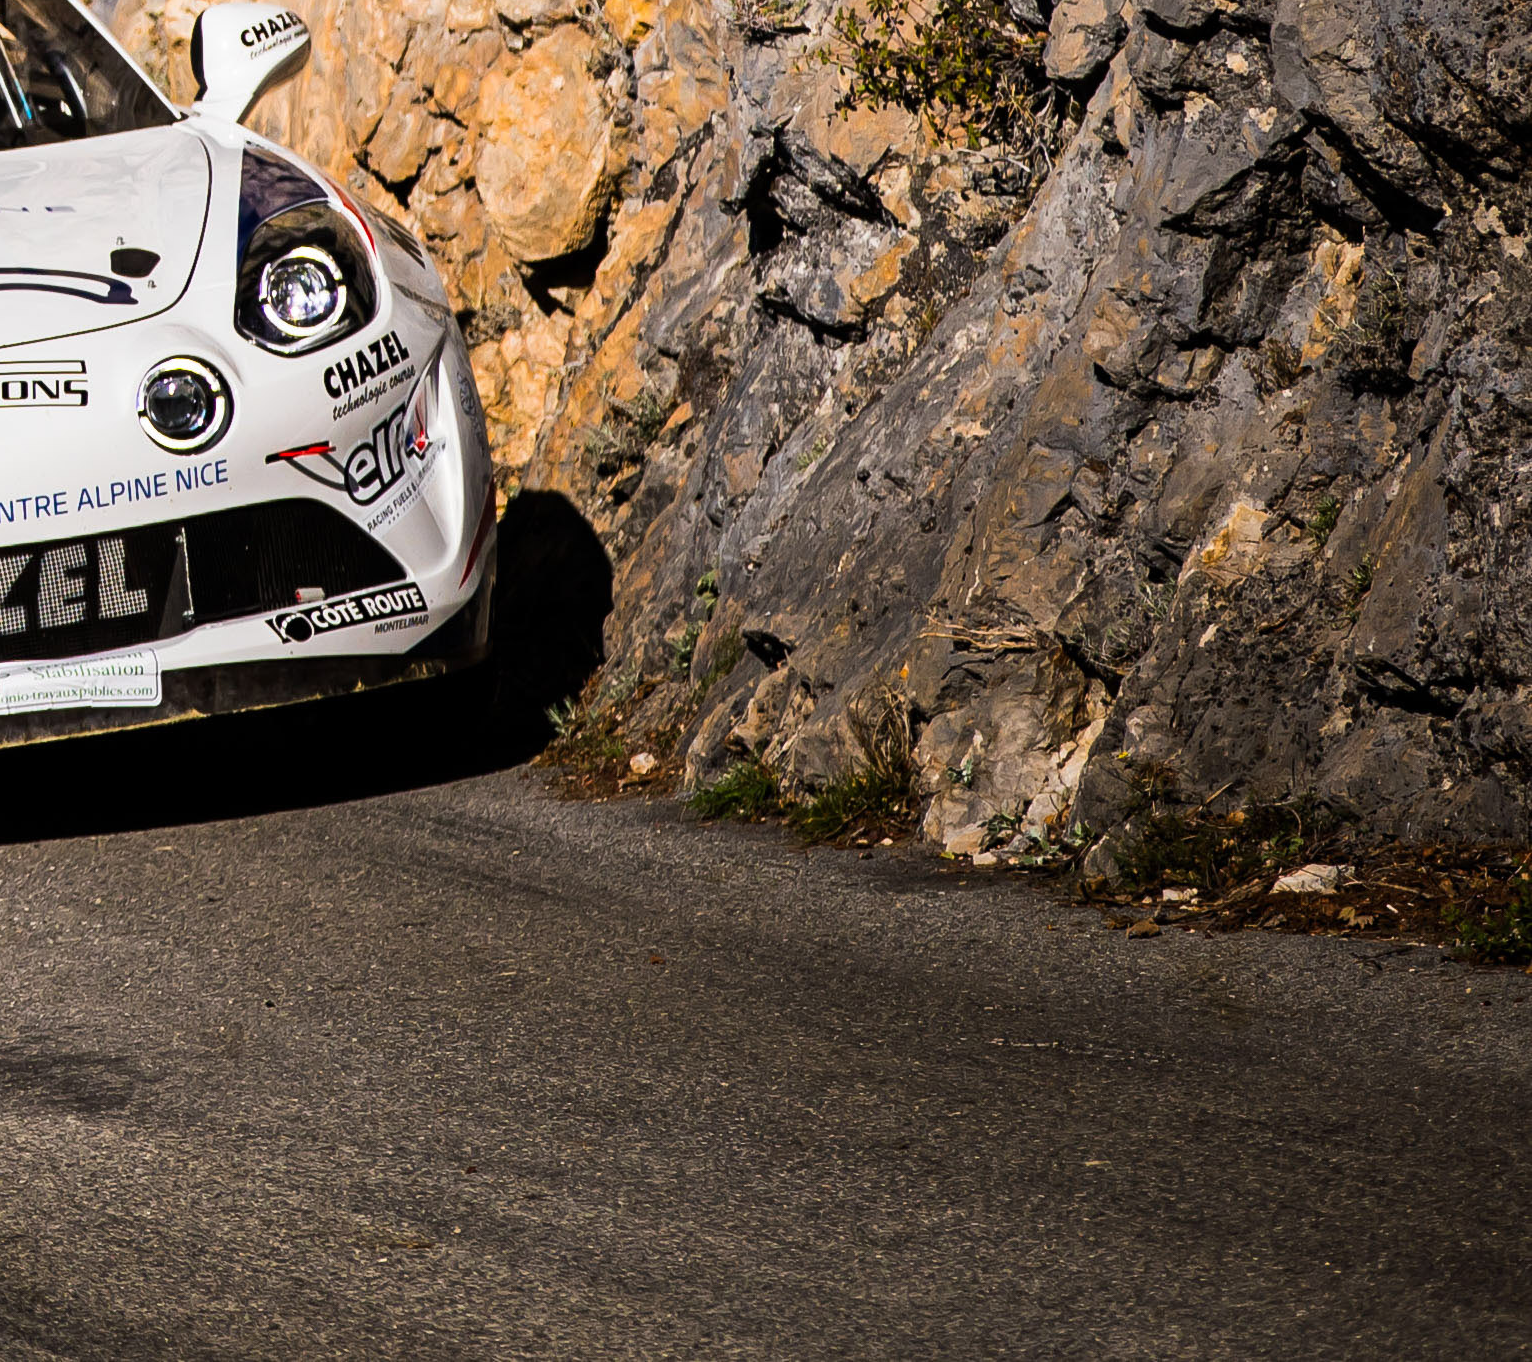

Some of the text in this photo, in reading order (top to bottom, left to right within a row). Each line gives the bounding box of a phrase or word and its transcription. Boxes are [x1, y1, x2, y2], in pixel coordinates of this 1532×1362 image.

[323, 330, 410, 400] CHAZEL
[77, 476, 167, 513] ALPINE
[176, 459, 230, 495] NICE
[310, 588, 424, 629] CÔTÉ ROUTE
[374, 615, 429, 635] MONTELIMAR
